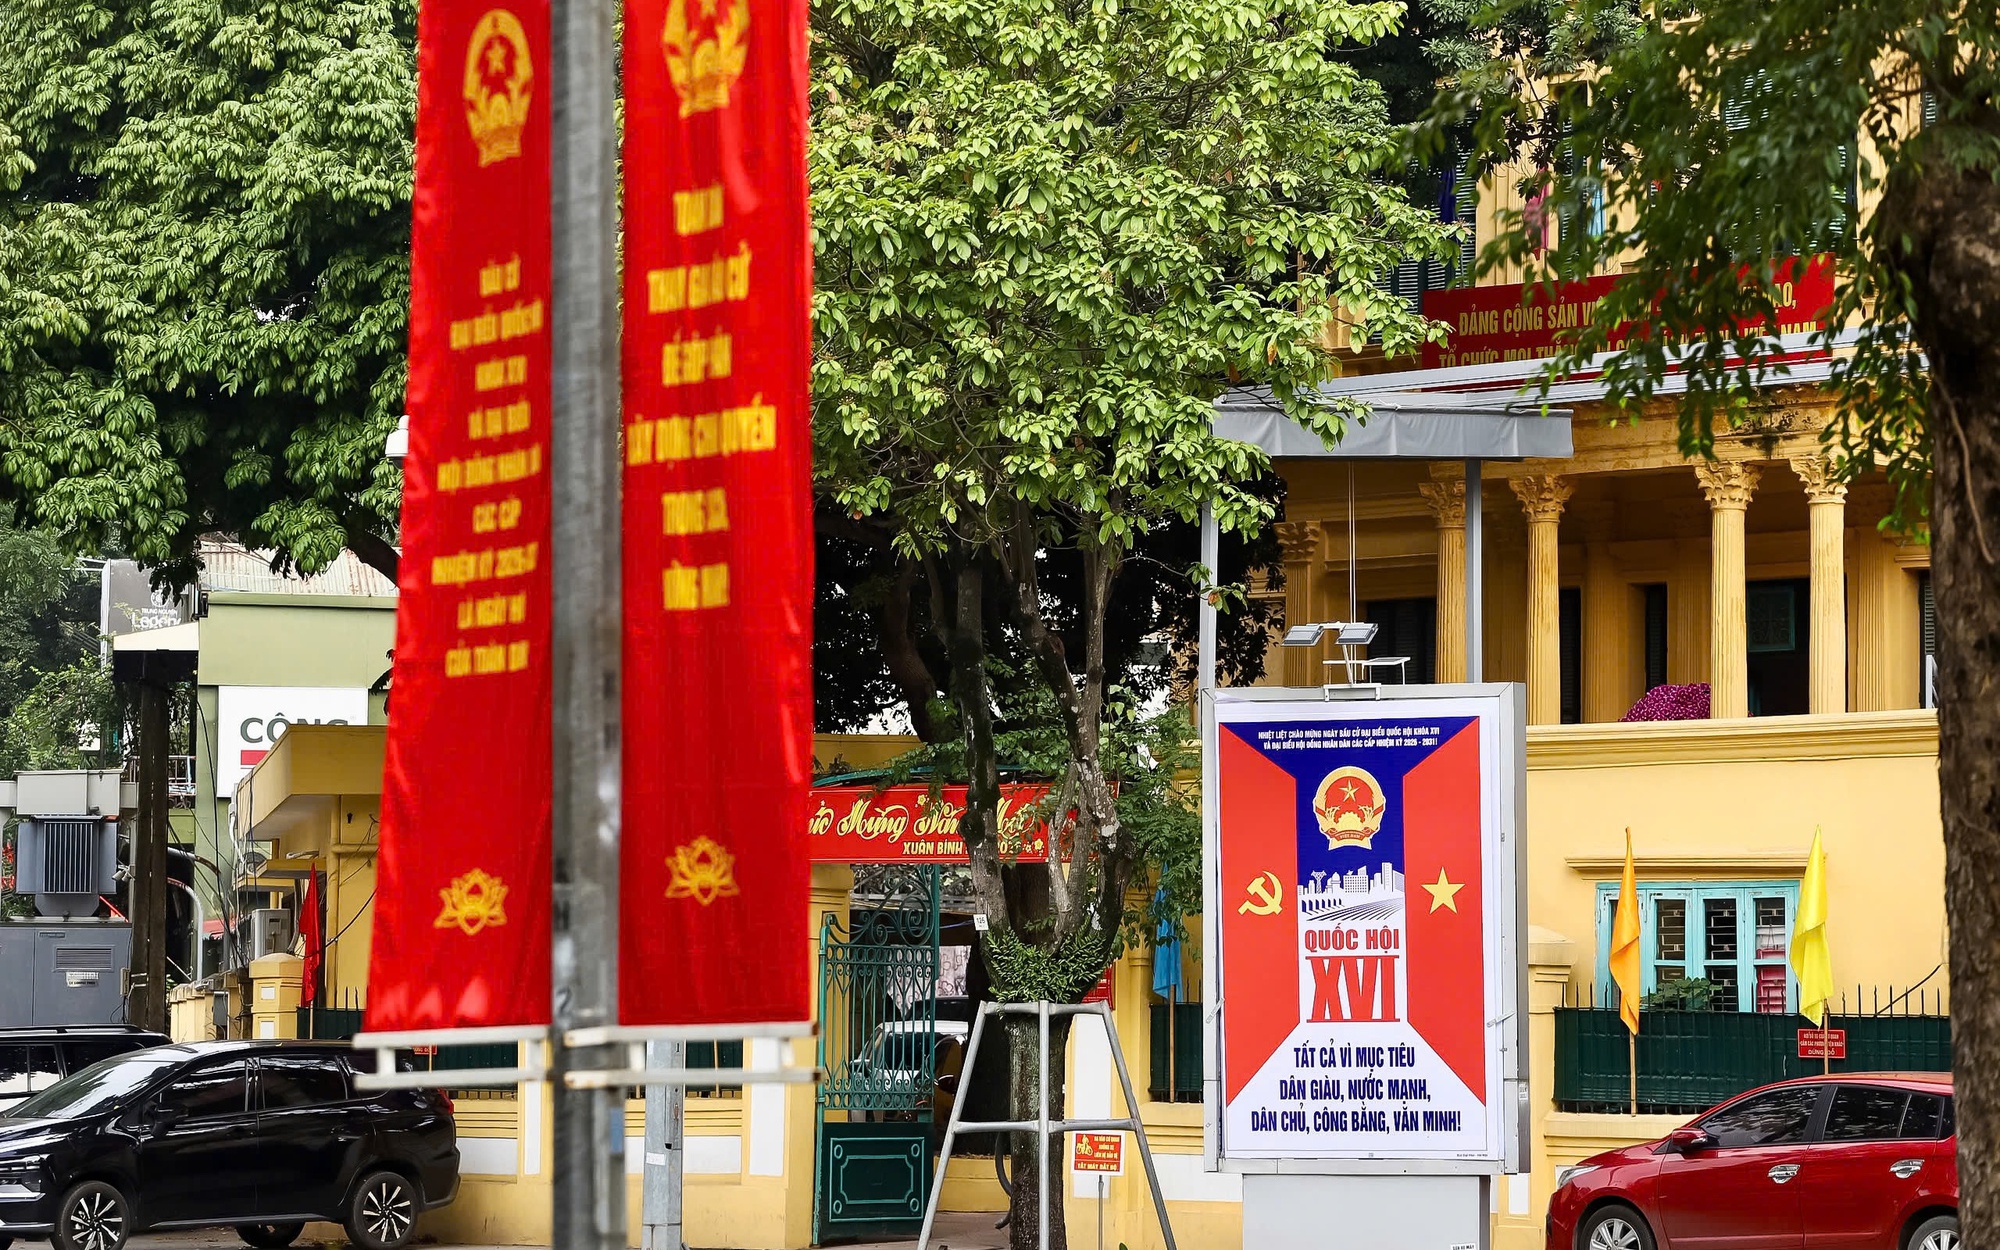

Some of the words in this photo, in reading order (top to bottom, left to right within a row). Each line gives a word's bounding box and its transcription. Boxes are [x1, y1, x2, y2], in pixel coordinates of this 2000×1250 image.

[1459, 303, 1499, 336] ĐẢNG
[1503, 302, 1543, 338] CỘNG
[1547, 296, 1578, 329] SẢN
[240, 712, 349, 744] CÔ
[1258, 730, 1274, 740] NHIỆT
[1276, 730, 1287, 740] LIỆT
[1288, 729, 1304, 739] CHÀO
[1304, 728, 1322, 738] MỪNG
[1323, 729, 1338, 738] NGÀY
[1339, 727, 1351, 738] BẦU
[1352, 726, 1360, 737] CỬ
[1361, 728, 1371, 738] ĐẠI
[1372, 725, 1385, 737] BIỂU
[1386, 725, 1401, 737] QUỐC
[1402, 727, 1412, 737] HỘI
[1430, 727, 1440, 735] XVI
[1263, 740, 1271, 750] VÀ
[1271, 741, 1281, 751] ĐẠI
[1282, 738, 1295, 750] BIỂU
[1296, 740, 1305, 750] HỘI
[1306, 738, 1321, 749] ĐỒNG
[1322, 739, 1338, 748] NHÂN
[1339, 738, 1350, 748] DÂN
[1351, 738, 1363, 748] CÁC
[1363, 737, 1376, 748] CẤP
[1376, 737, 1394, 748] NHIỆM
[1395, 737, 1403, 747] KỲ
[1403, 738, 1417, 746] 2026
[836, 798, 910, 843] Mừng
[902, 838, 934, 855] XUÂN
[937, 838, 963, 855] BÍNH
[1305, 922, 1359, 952] QUỐC
[1365, 925, 1399, 954] HỘI
[1305, 955, 1400, 1023] XVI
[1294, 1040, 1316, 1068] TẤT
[1319, 1038, 1336, 1068] CẢ
[1339, 1043, 1352, 1068] VÌ
[1355, 1047, 1384, 1073] MỤC
[1387, 1042, 1415, 1068] TIÊU
[1279, 1075, 1306, 1100] DÂN
[1310, 1076, 1345, 1102] GIÀU,
[1348, 1072, 1384, 1100] NƯỚC
[1387, 1079, 1431, 1105] MẠNH,
[1251, 1107, 1277, 1132] DÂN
[1281, 1102, 1310, 1134] CHỦ,
[1313, 1107, 1348, 1132] CÔNG
[1351, 1101, 1390, 1135] BẰNG,
[1393, 1106, 1419, 1132] VĂN
[1422, 1110, 1461, 1132] MINH!
